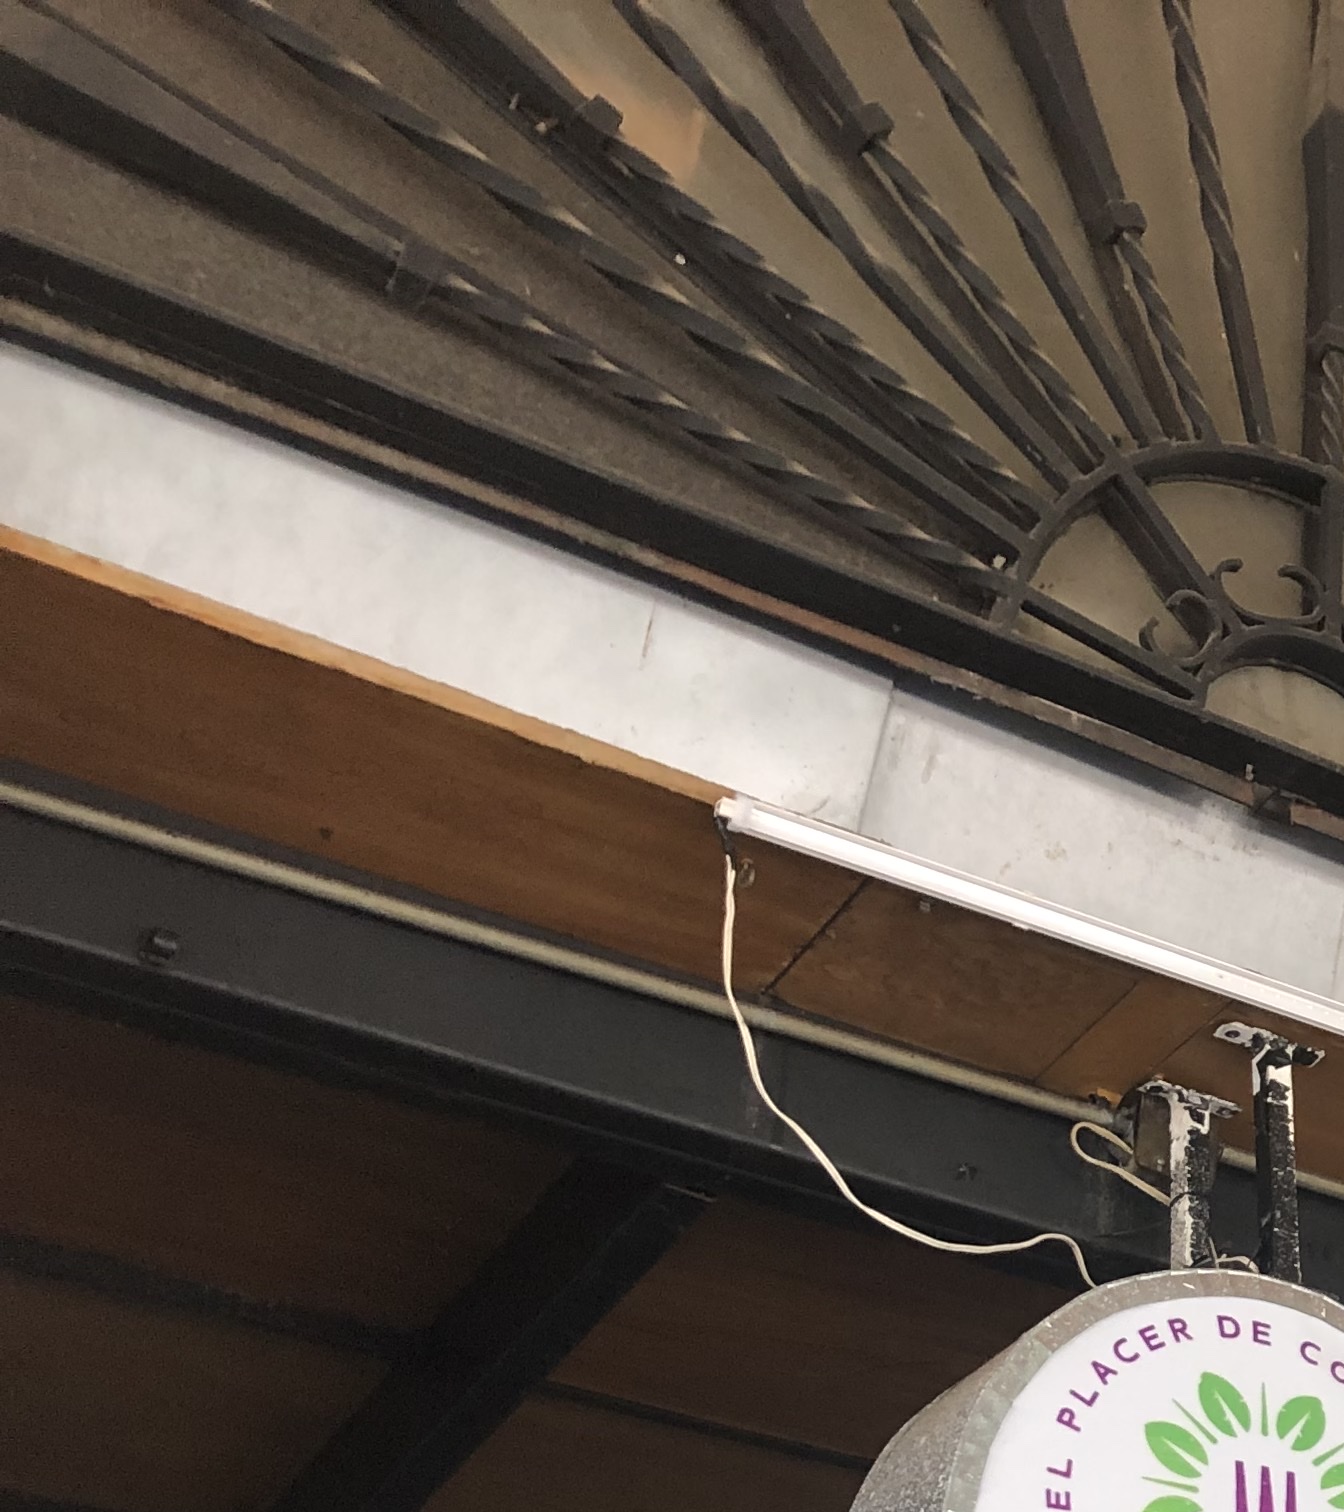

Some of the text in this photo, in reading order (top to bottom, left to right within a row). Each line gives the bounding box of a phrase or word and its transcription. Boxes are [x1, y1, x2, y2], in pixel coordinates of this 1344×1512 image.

[1216, 1315, 1272, 1346] DE
[1057, 1317, 1193, 1432] PLACER
[1046, 1459, 1073, 1512] EL
